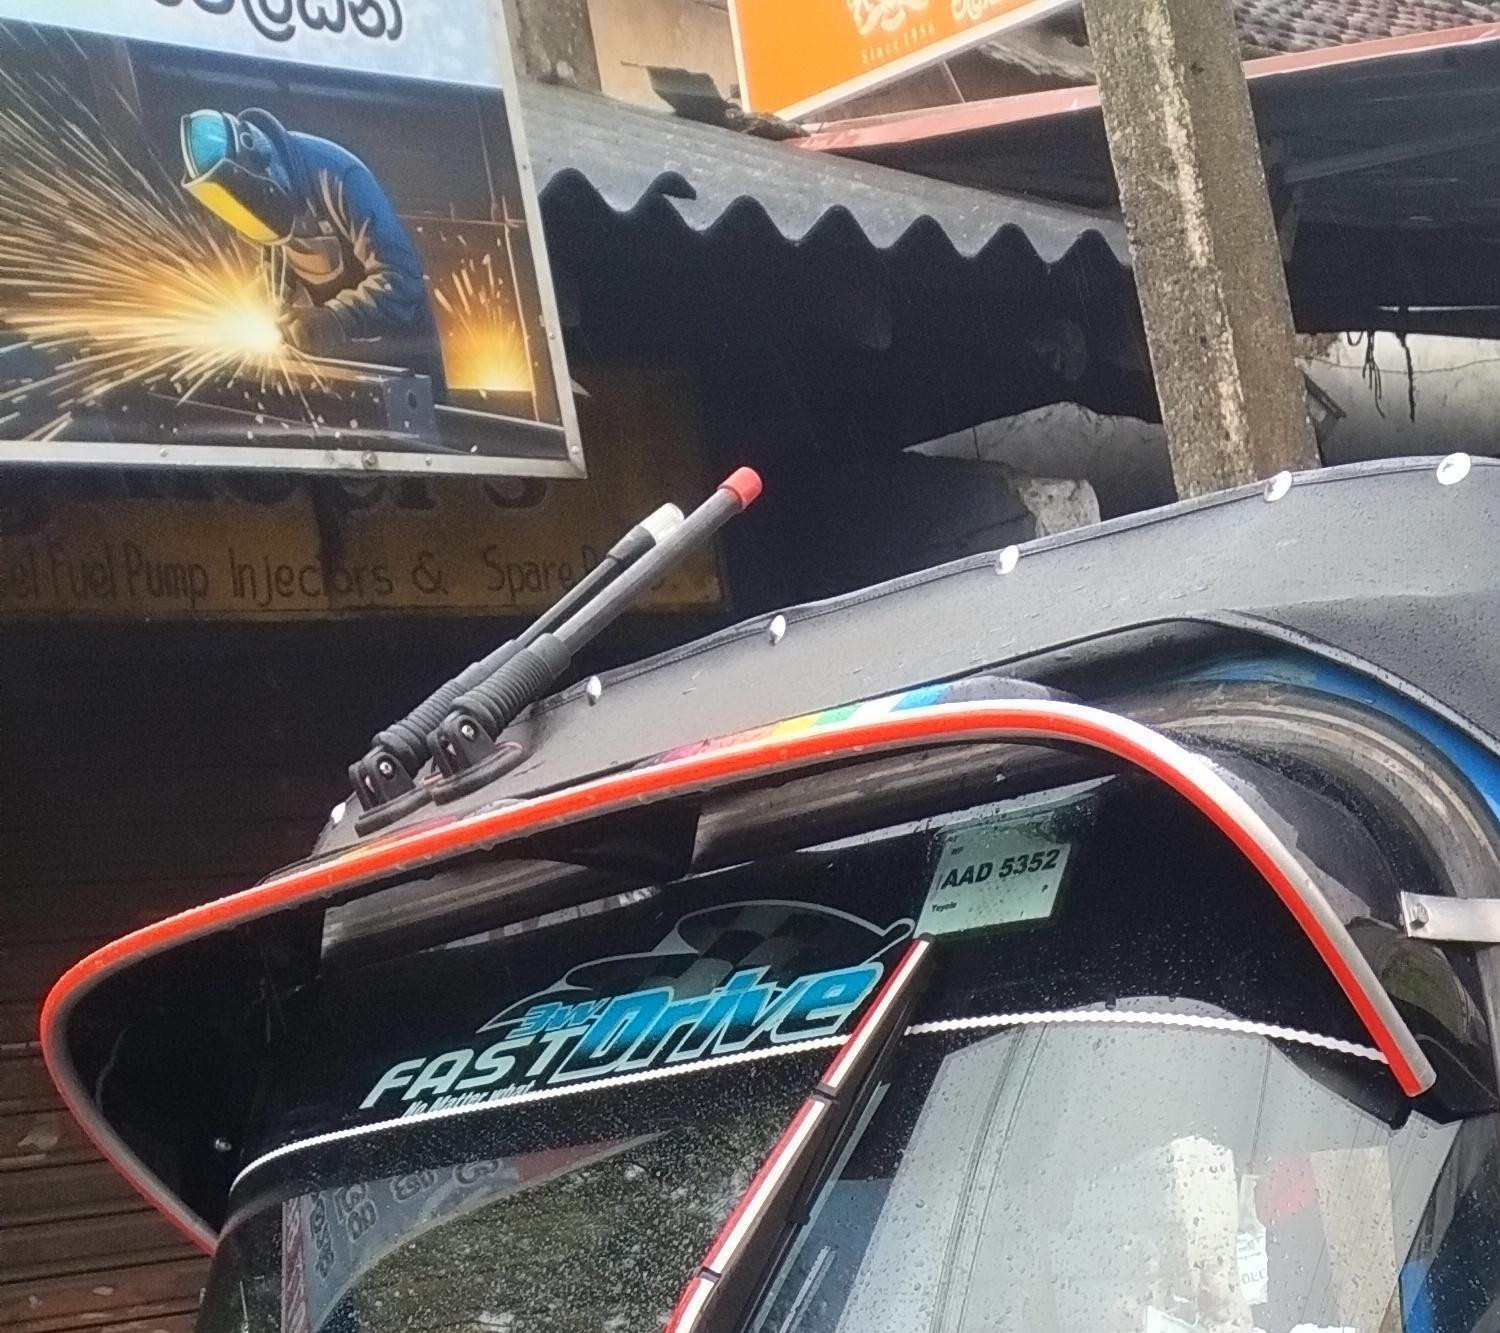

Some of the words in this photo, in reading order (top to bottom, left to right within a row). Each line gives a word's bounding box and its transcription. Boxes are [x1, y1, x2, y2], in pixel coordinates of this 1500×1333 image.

[124, 541, 209, 606] Pump
[228, 547, 394, 607] Injectors
[412, 551, 449, 596] &
[484, 543, 574, 598] Spare
[941, 862, 993, 889] AAD
[999, 848, 1060, 878] 5352
[359, 1028, 598, 1110] FAST
[547, 960, 885, 1084] Drive
